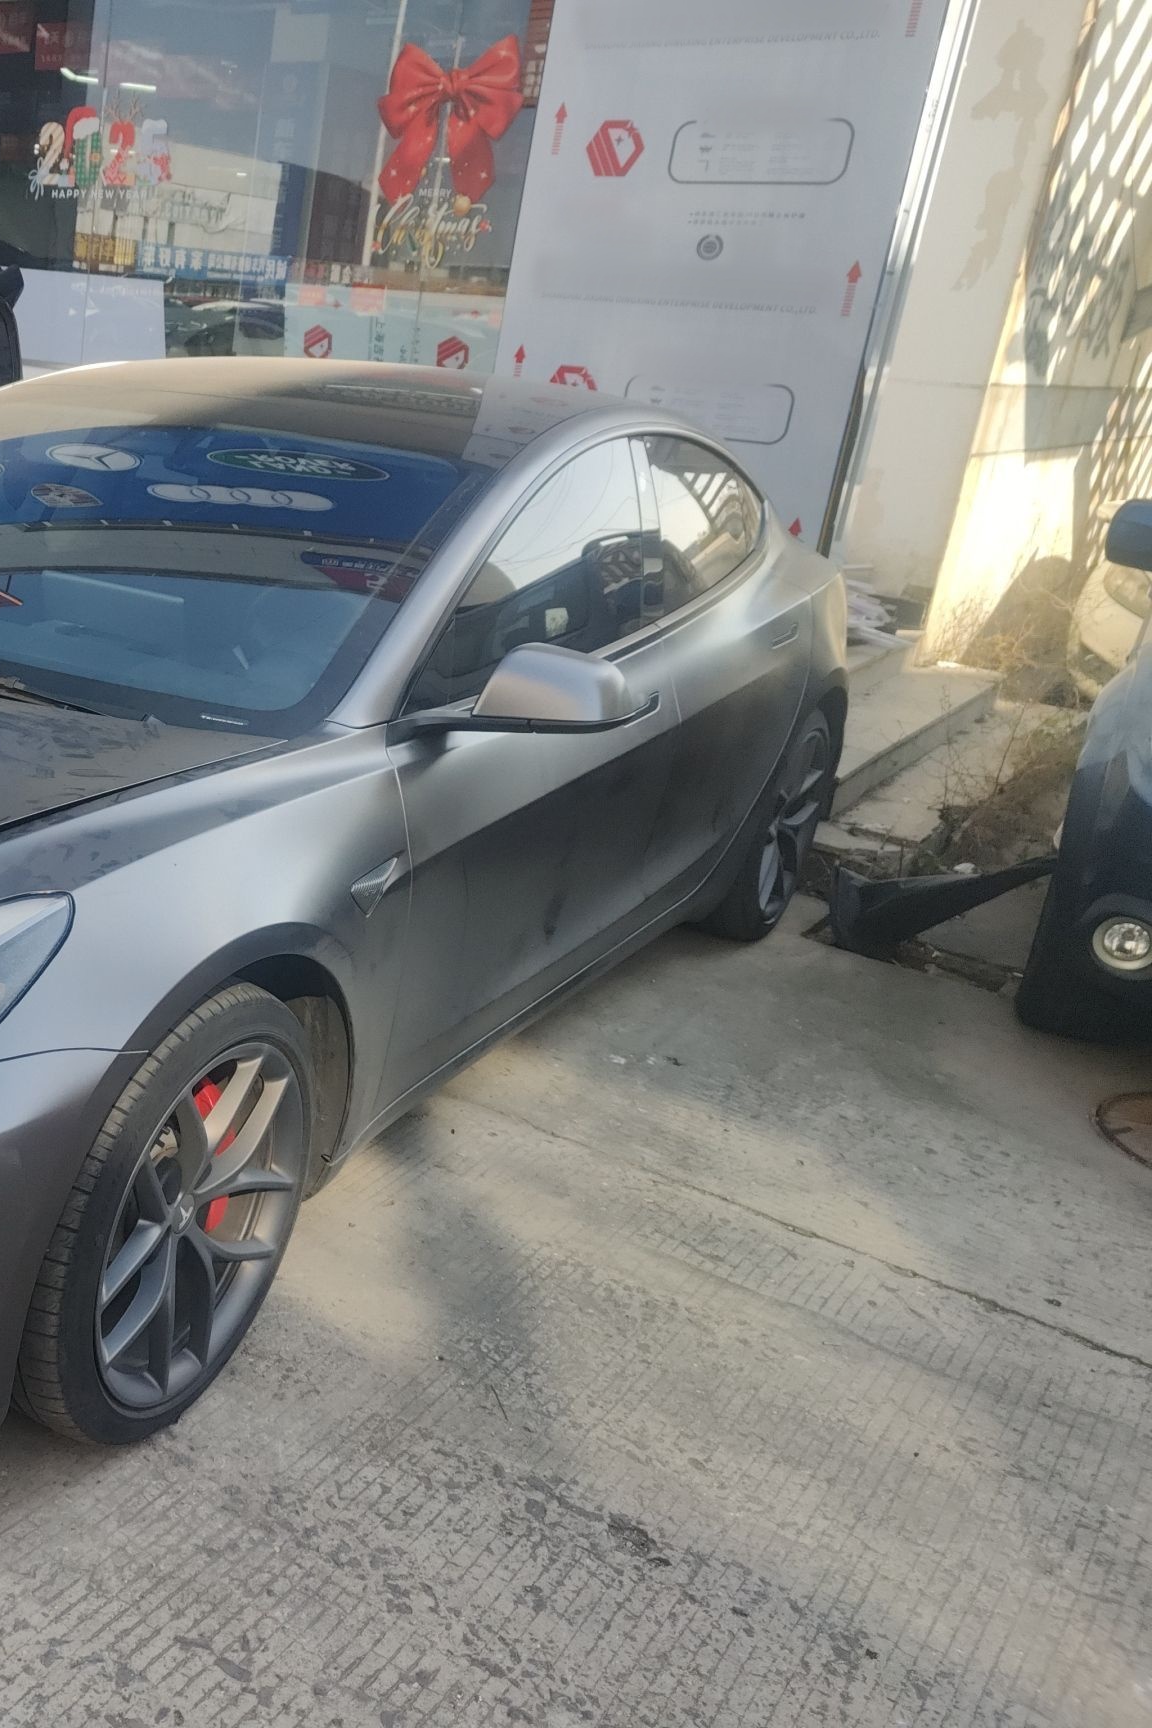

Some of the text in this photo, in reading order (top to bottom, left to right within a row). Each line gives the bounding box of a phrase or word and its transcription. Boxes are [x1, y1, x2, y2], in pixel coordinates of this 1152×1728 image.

[709, 35, 765, 46] ENTERPRISE
[767, 32, 838, 44] DEVELOPMENT
[52, 189, 148, 200] HAPPY NEW YEAR
[418, 188, 453, 198] MERRY
[376, 193, 488, 269] Christmas
[657, 298, 711, 309] ENTERPRISE
[712, 301, 779, 313] DEVELOPMENT
